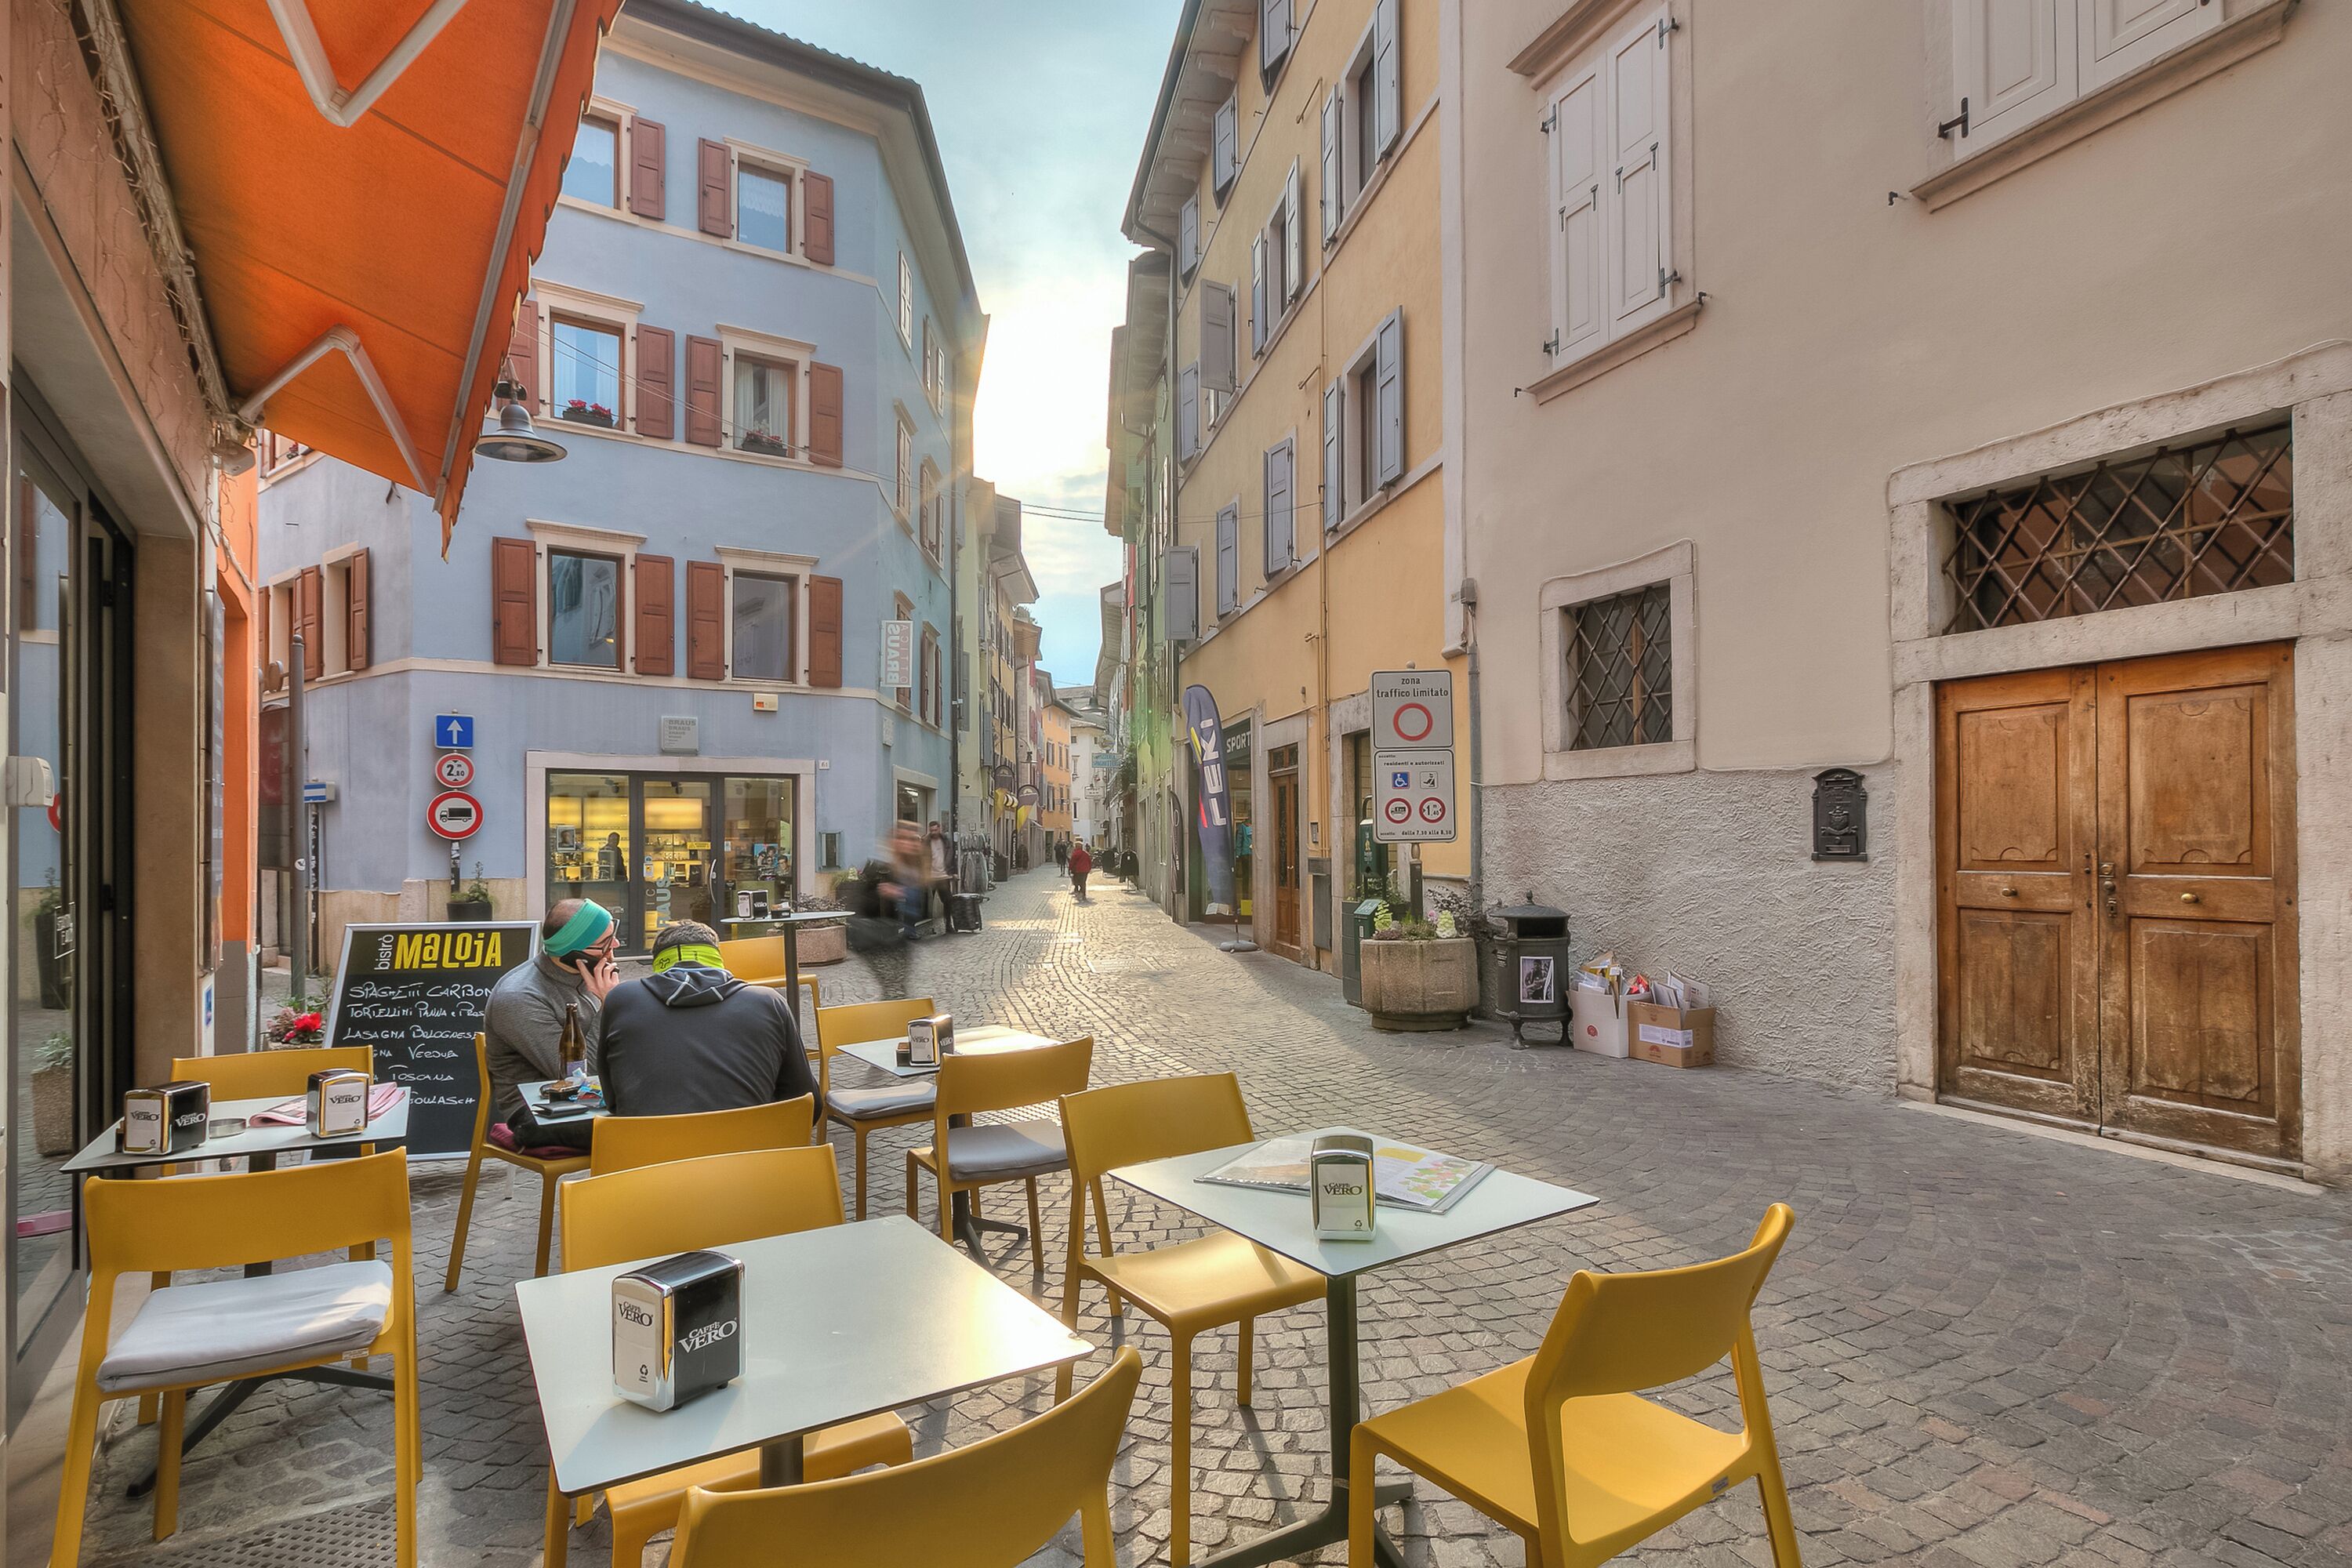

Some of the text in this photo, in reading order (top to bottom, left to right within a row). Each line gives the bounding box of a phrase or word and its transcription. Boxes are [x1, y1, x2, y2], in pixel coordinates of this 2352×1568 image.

[1377, 688, 1449, 698] traffico limitato
[1226, 731, 1251, 753] SPORT
[1200, 718, 1227, 827] LEKI
[656, 877, 672, 928] RAUS
[373, 934, 394, 971] bistrò
[342, 1027, 405, 1040] LASAGNA
[387, 1064, 455, 1081] TOSCANA
[328, 1094, 362, 1104] VERO
[129, 1112, 161, 1122] VERO
[175, 1112, 206, 1127] VERO
[1323, 1185, 1363, 1196] VERO
[617, 1302, 653, 1327] VERO
[677, 1319, 738, 1354] VERO
